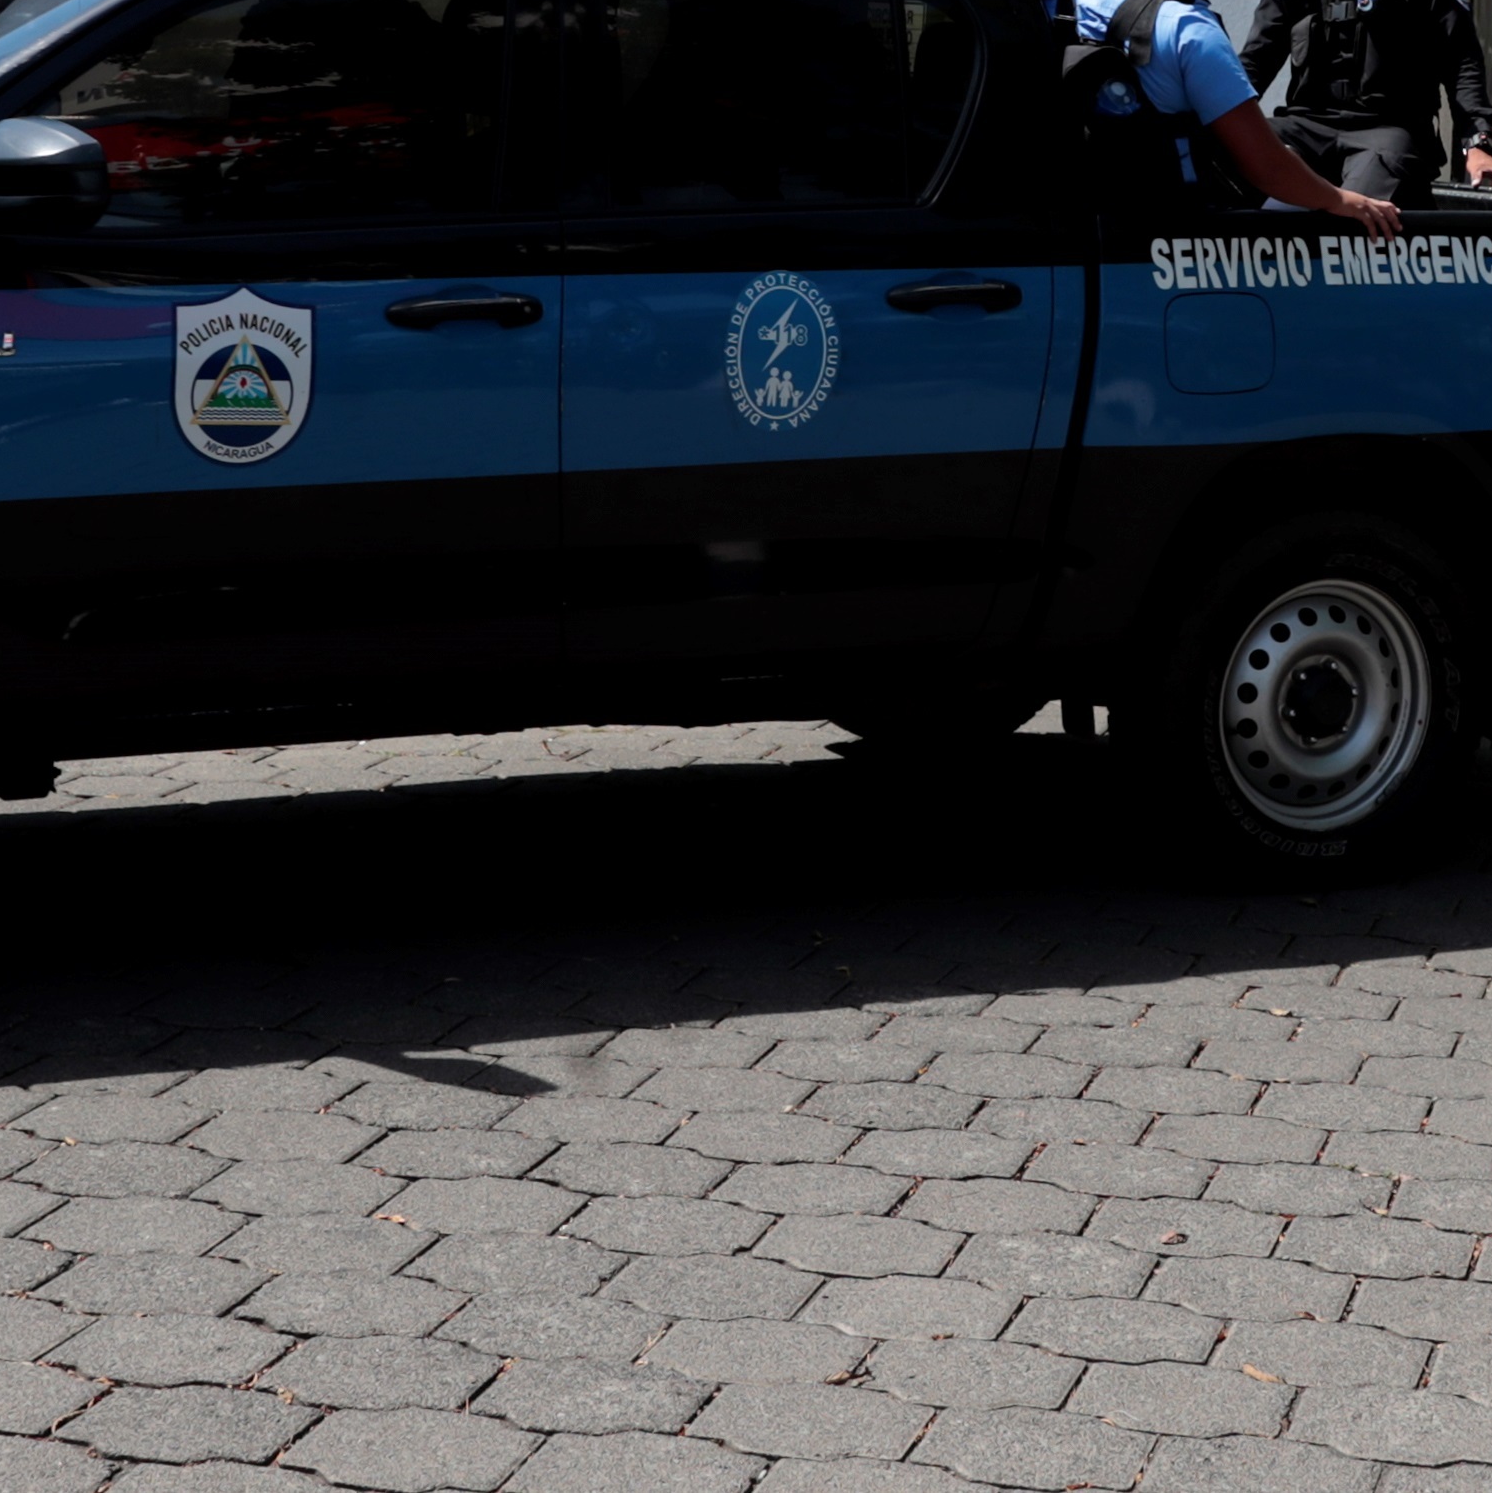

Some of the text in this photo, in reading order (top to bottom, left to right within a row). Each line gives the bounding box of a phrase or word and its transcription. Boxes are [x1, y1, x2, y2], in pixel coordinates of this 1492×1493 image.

[1150, 237, 1311, 290] SERVICIO
[179, 312, 309, 358] POLICIA NACIONAL
[724, 273, 839, 428] DIRECCIÓN DE PROTECCIÓN CIUDADANA
[203, 440, 275, 460] NICARAGUA
